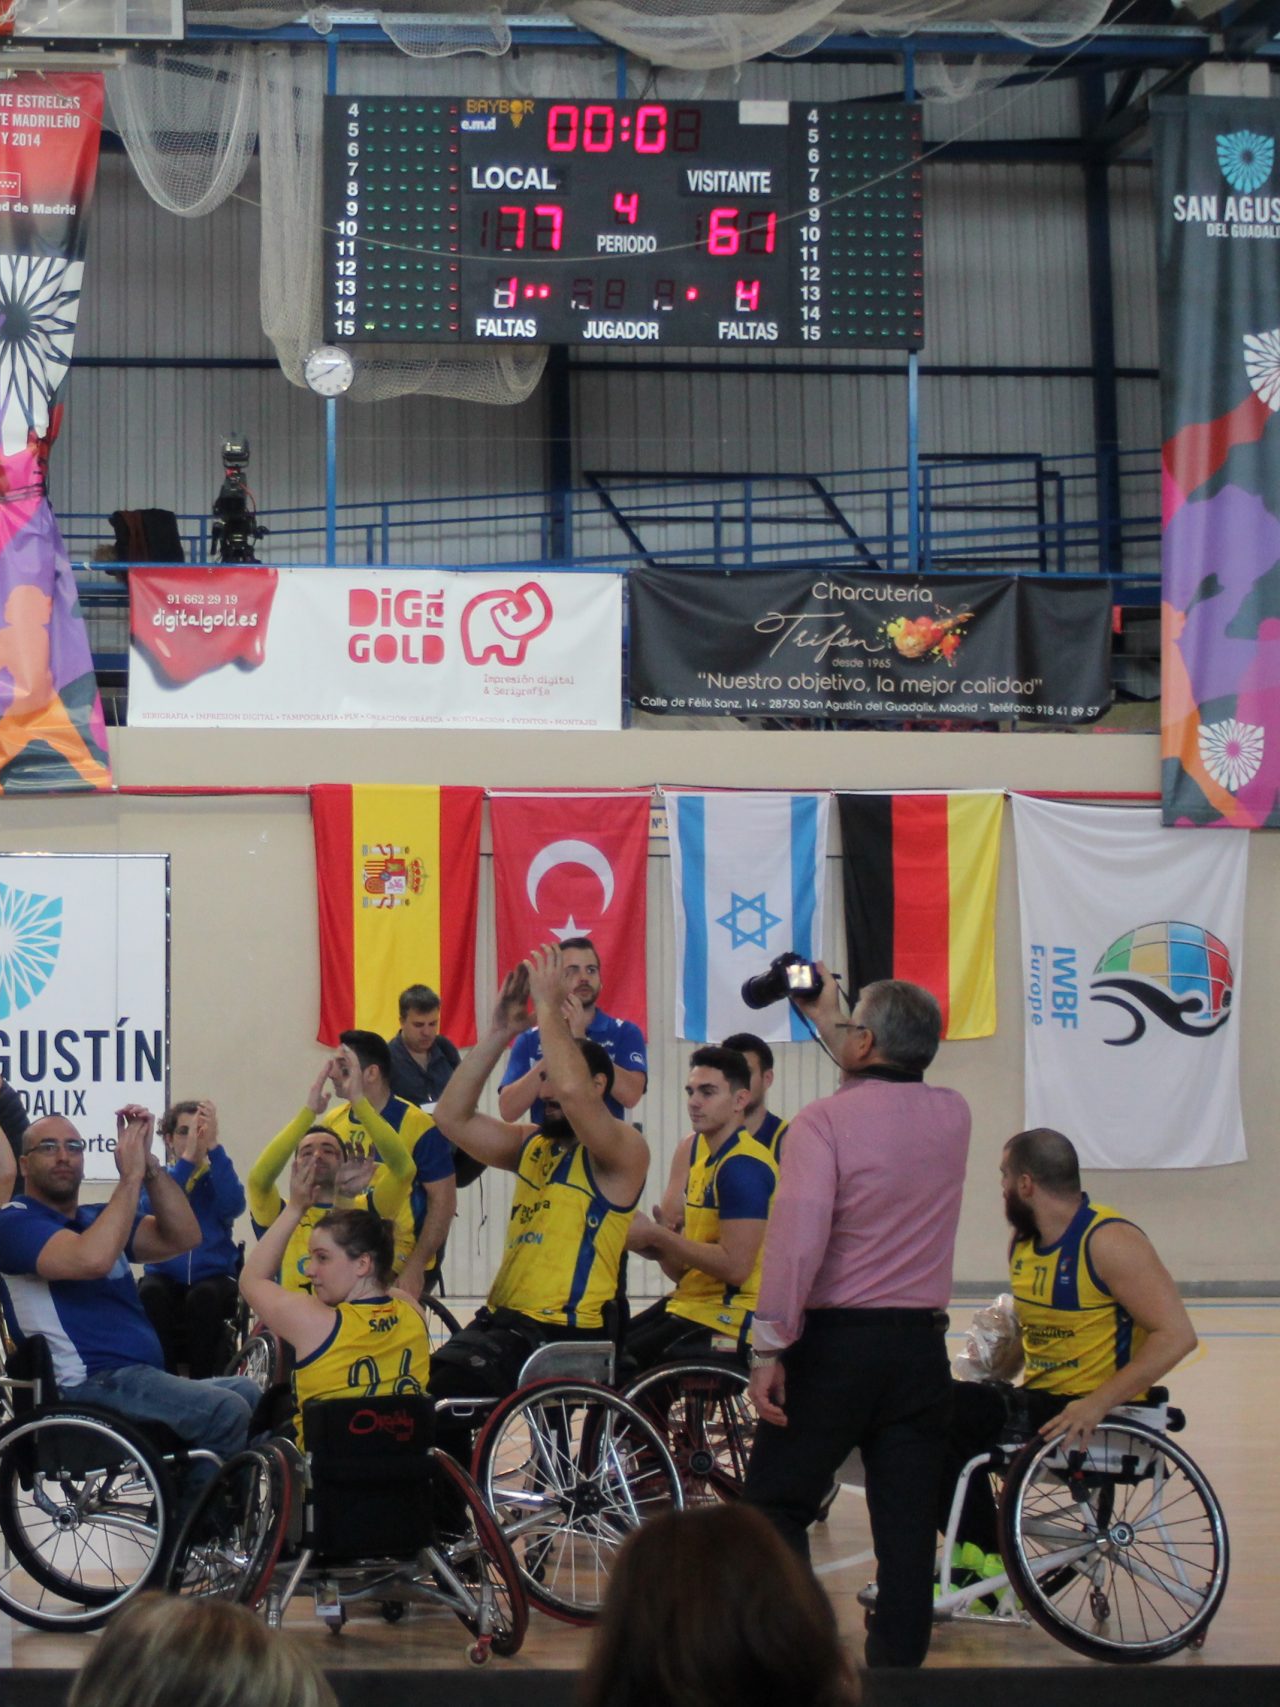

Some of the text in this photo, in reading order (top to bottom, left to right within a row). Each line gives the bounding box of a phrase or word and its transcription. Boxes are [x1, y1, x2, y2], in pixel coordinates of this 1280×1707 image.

[17, 95, 81, 109] ESTRELLAS
[348, 103, 360, 117] 4
[807, 109, 819, 123] 4
[12, 113, 81, 128] MADRILEÑO
[348, 123, 359, 136] 5
[808, 129, 819, 142] 5
[1, 133, 9, 145] Y
[12, 133, 41, 147] 2014
[347, 142, 359, 156] 6
[808, 149, 819, 162] 6
[347, 162, 359, 176] 7
[808, 168, 820, 182] 7
[472, 167, 557, 190] LOCAL
[687, 169, 771, 193] VISITANTE
[347, 182, 359, 196] 8
[808, 188, 820, 202] 8
[13, 202, 29, 214] de
[32, 203, 76, 215] Madrid
[346, 202, 358, 215] 9
[614, 192, 638, 224] 4
[809, 208, 821, 222] 9
[1173, 195, 1280, 223] SAN AGUS
[337, 221, 358, 235] 10
[499, 205, 564, 250] 77
[708, 208, 777, 256] 61
[800, 227, 821, 241] 10
[1206, 222, 1280, 238] DEL GUADALI
[336, 241, 355, 255] 11
[596, 233, 657, 253] PERIODO
[800, 247, 819, 261] 11
[336, 261, 356, 275] 12
[800, 267, 821, 281] 12
[335, 281, 356, 295] 13
[800, 286, 821, 300] 13
[335, 301, 356, 315] 14
[801, 306, 821, 320] 14
[335, 321, 356, 335] 15
[476, 319, 537, 337] FALTAS
[583, 321, 659, 340] JUGADOR
[718, 321, 778, 341] FALTAS
[801, 326, 821, 340] 15
[812, 581, 933, 602] Charcutería
[167, 594, 238, 605] 91 662 29 19
[152, 608, 258, 633] digitalgold.es
[754, 612, 885, 663] Trifón
[349, 634, 445, 664] GOLD
[832, 658, 891, 668] desde 1965
[538, 674, 574, 686] digital
[787, 673, 871, 693] objetivo,
[877, 676, 895, 692] la
[900, 676, 955, 696] mejor
[483, 687, 490, 695] &
[640, 696, 667, 708] Calle
[671, 697, 685, 708] de
[688, 697, 712, 708] Félix
[746, 699, 758, 709] 14
[770, 699, 800, 709] 28750
[803, 699, 823, 710] San
[825, 700, 862, 712] Agustín
[865, 701, 883, 711] del
[940, 703, 978, 713] Madrid
[989, 702, 1035, 714] Teléfono:
[1036, 705, 1054, 716] 918
[1056, 706, 1067, 716] 41
[1071, 706, 1084, 717] 89
[1086, 707, 1100, 717] 57
[1028, 944, 1045, 1026] Europe
[1051, 947, 1078, 1029] IWBF
[20, 1089, 87, 1116] DALIX
[1032, 1266, 1047, 1296] 11
